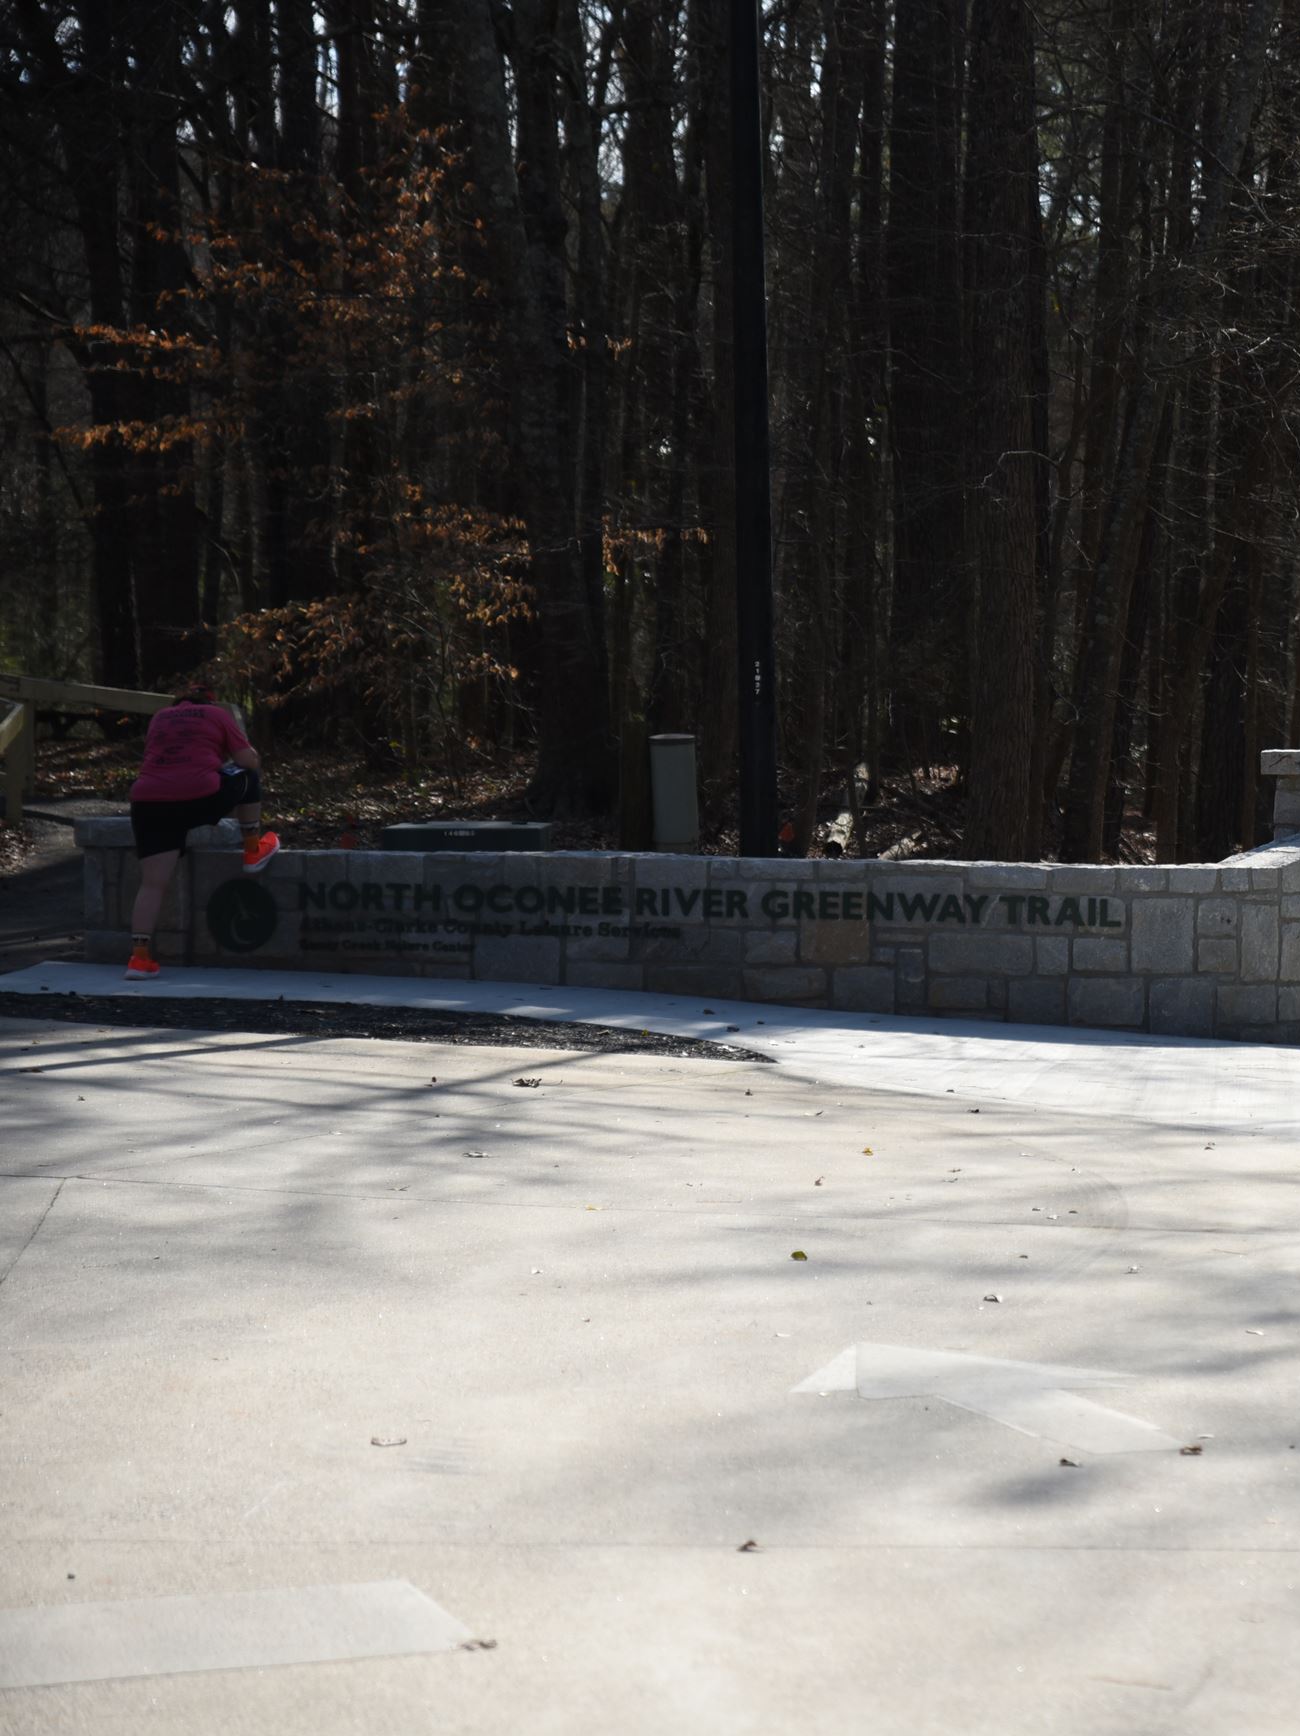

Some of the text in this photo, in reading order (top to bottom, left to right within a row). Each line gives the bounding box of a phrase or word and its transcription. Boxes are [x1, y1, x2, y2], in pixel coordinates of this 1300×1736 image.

[299, 882, 1121, 927] NORTH OCONEE RIVER GREENWAY TRAIL
[444, 917, 512, 938] County
[598, 922, 681, 938] Services
